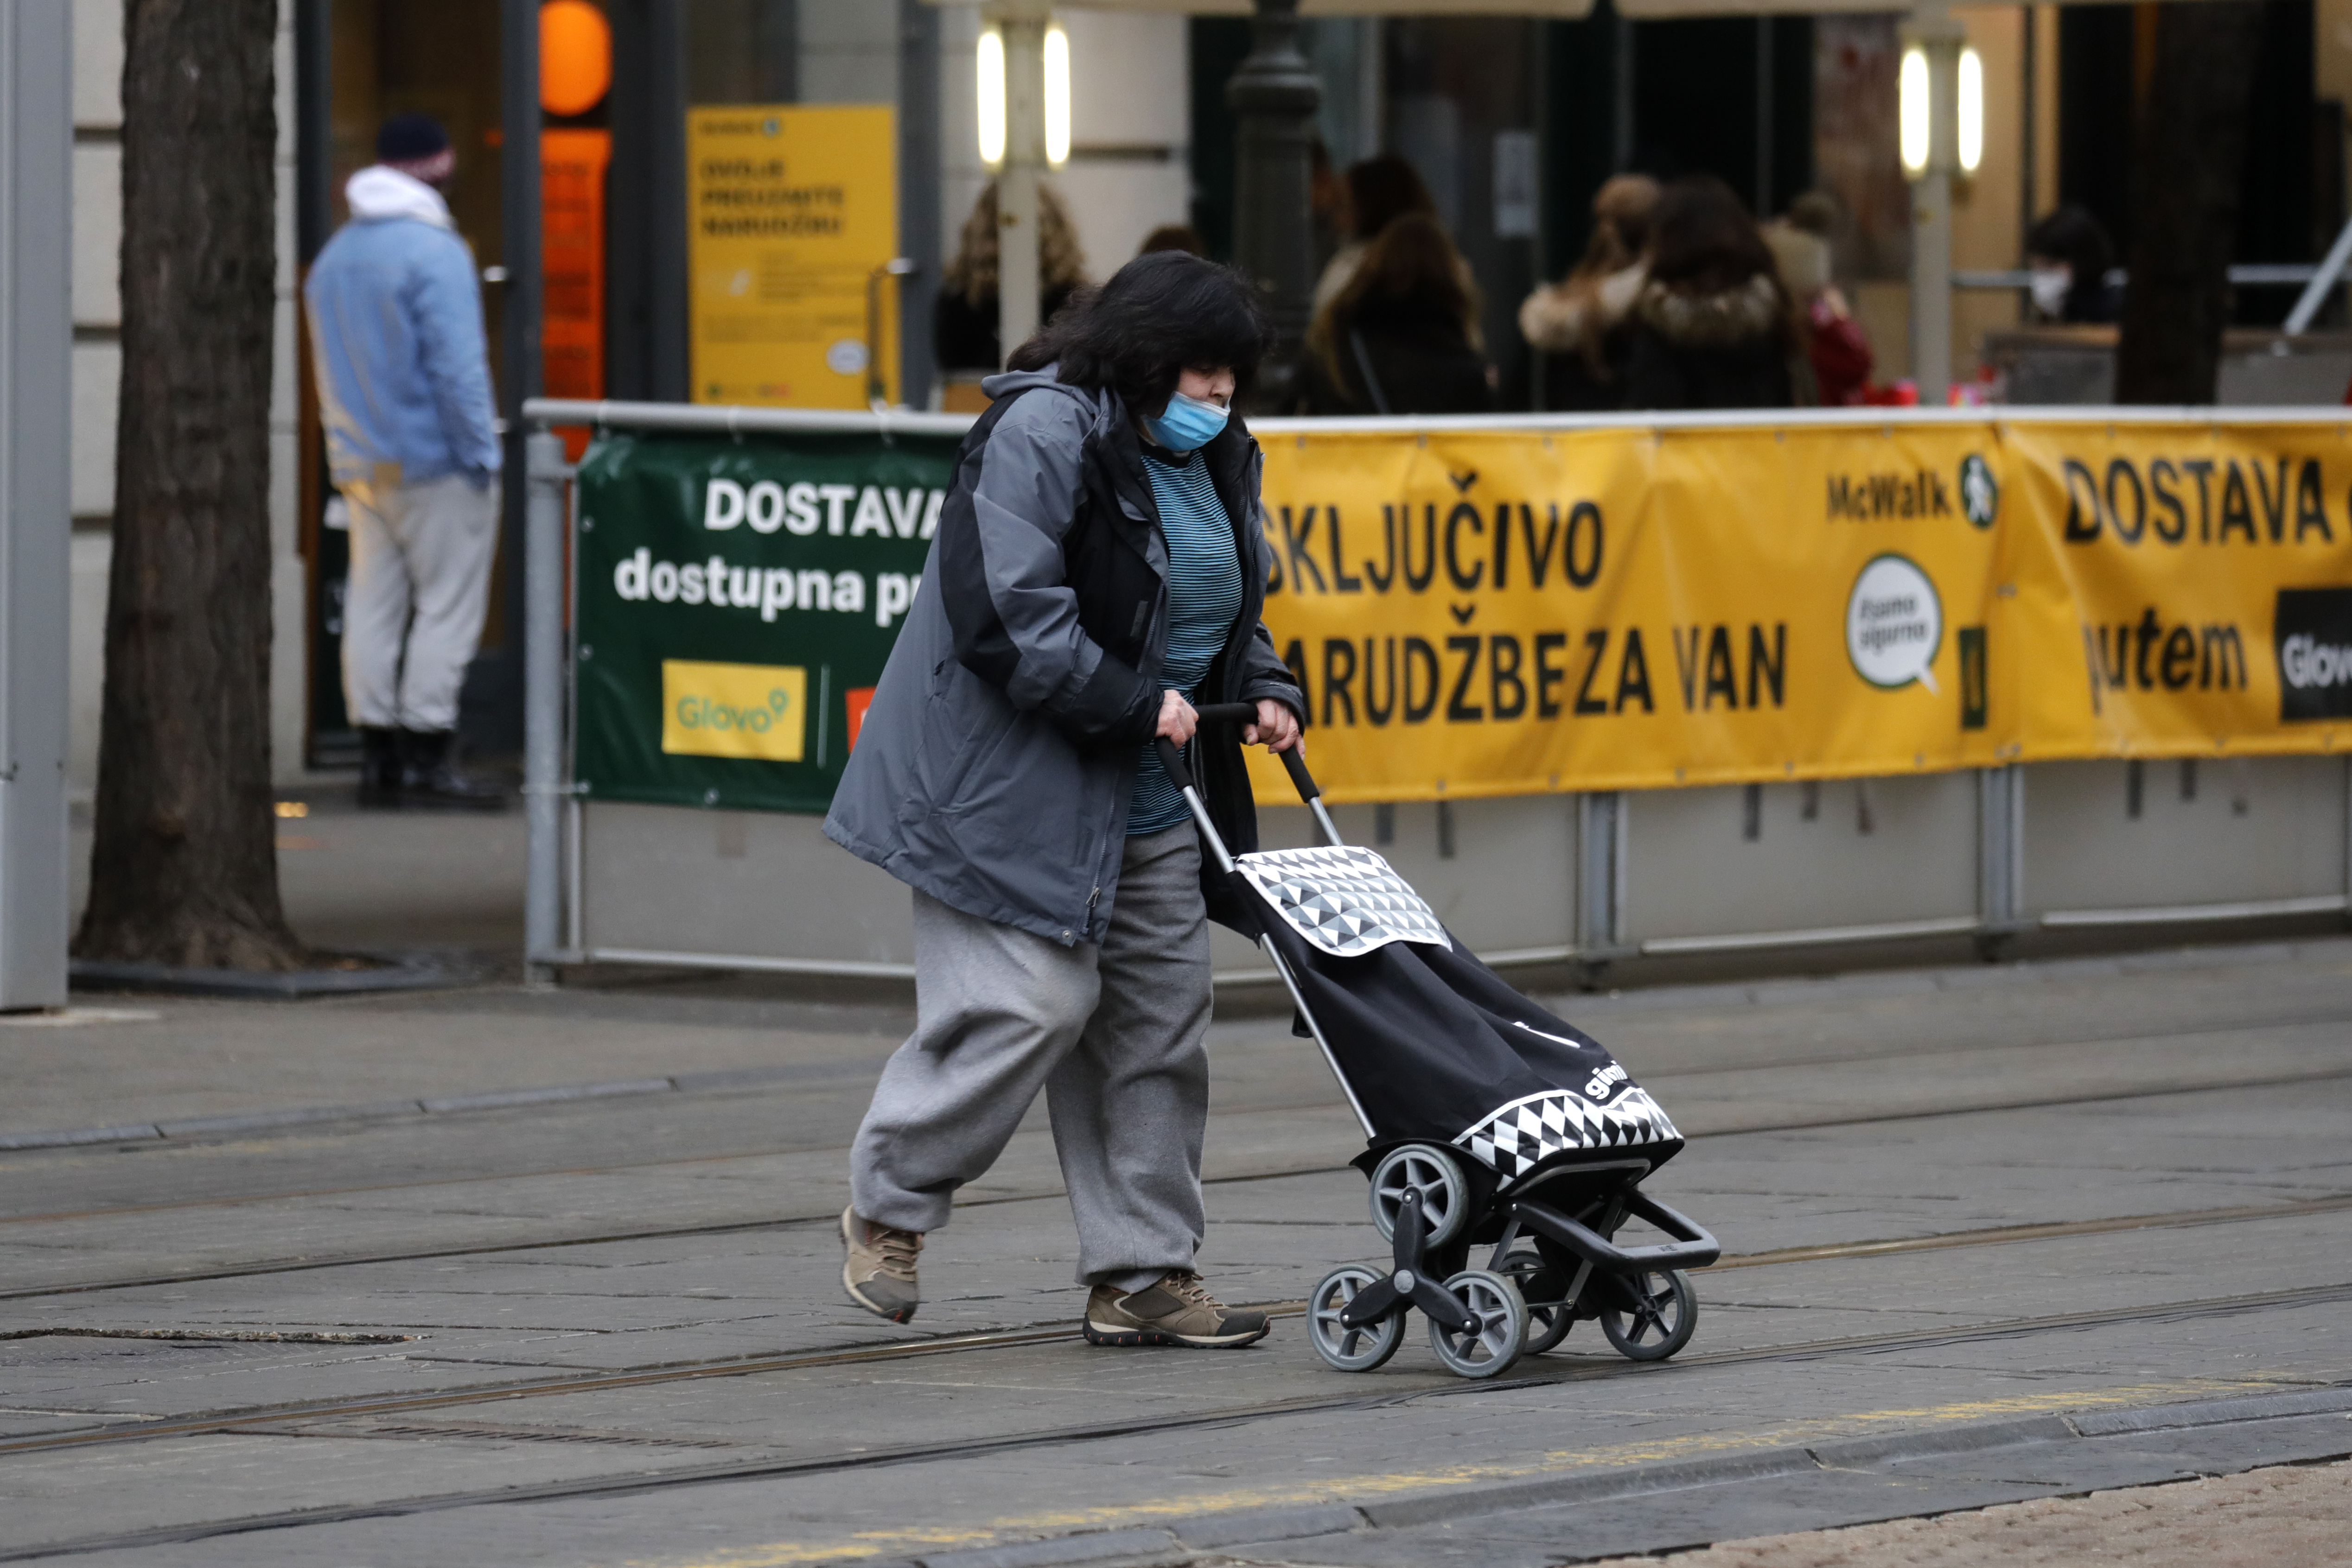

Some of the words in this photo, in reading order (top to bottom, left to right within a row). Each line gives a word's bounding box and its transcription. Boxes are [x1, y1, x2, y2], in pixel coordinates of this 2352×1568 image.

[704, 477, 946, 540] DOSTAVA
[1825, 468, 1953, 523] McWalk
[2059, 455, 2334, 546] DOSTAVA
[613, 546, 866, 623] dostupna
[1573, 627, 1655, 716] ZA
[1672, 622, 1787, 713] VAN
[676, 692, 774, 734] Glovo
